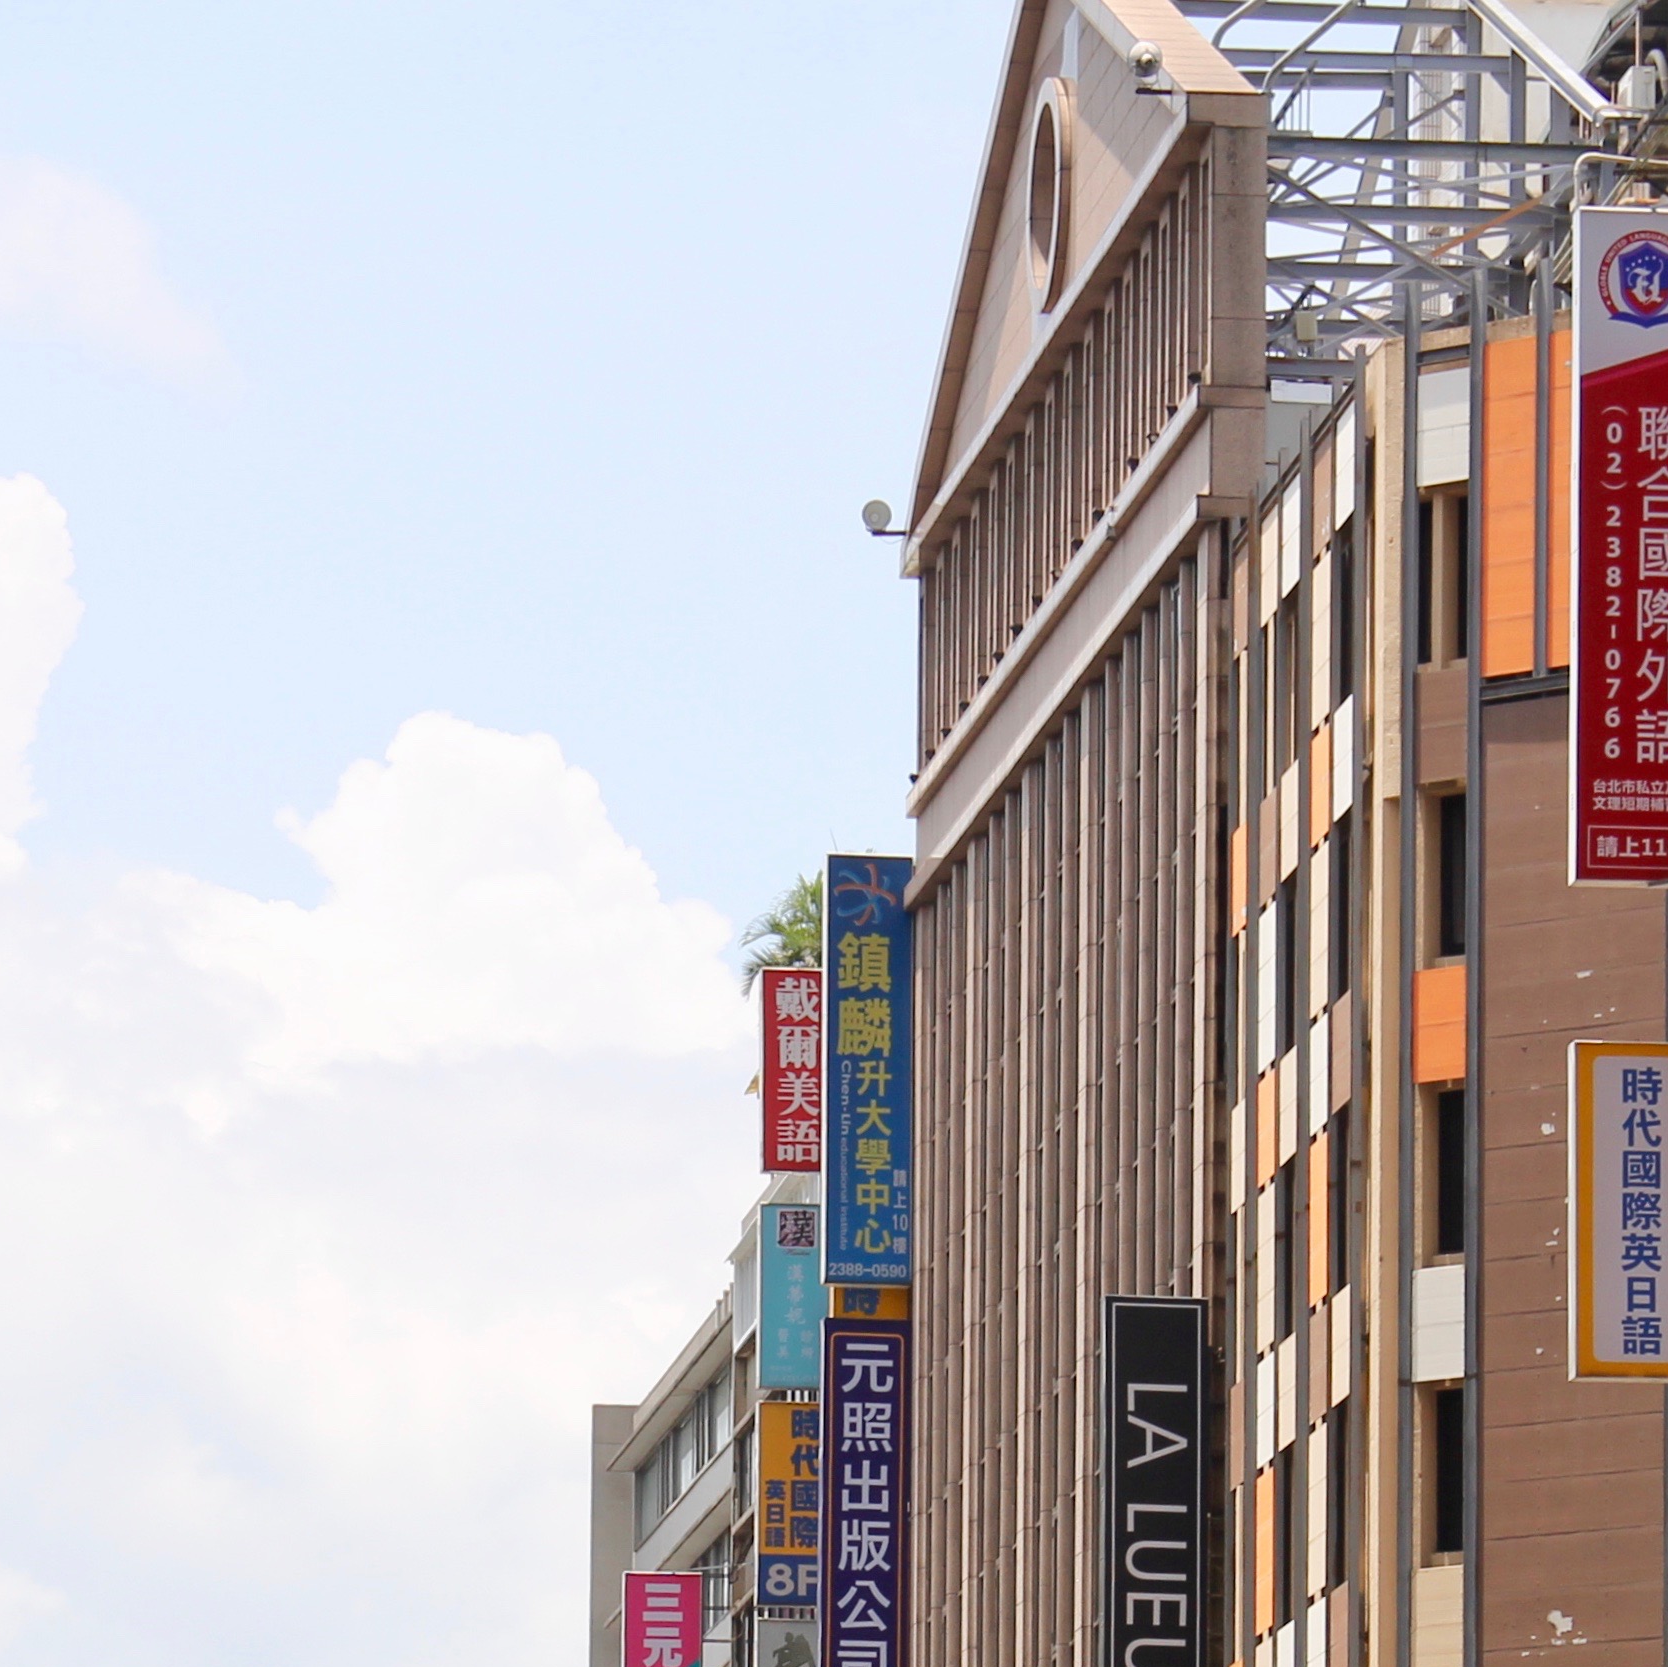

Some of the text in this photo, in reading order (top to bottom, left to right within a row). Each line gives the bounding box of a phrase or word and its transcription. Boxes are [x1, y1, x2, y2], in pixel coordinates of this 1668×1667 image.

[775, 976, 820, 1164] 戴爾美語
[1621, 1067, 1663, 1355] 時代國際英日語
[829, 1261, 907, 1278] 2388-0590
[1126, 1383, 1189, 1468] LA
[765, 1479, 786, 1549] 英日語
[765, 1564, 819, 1597] 8F
